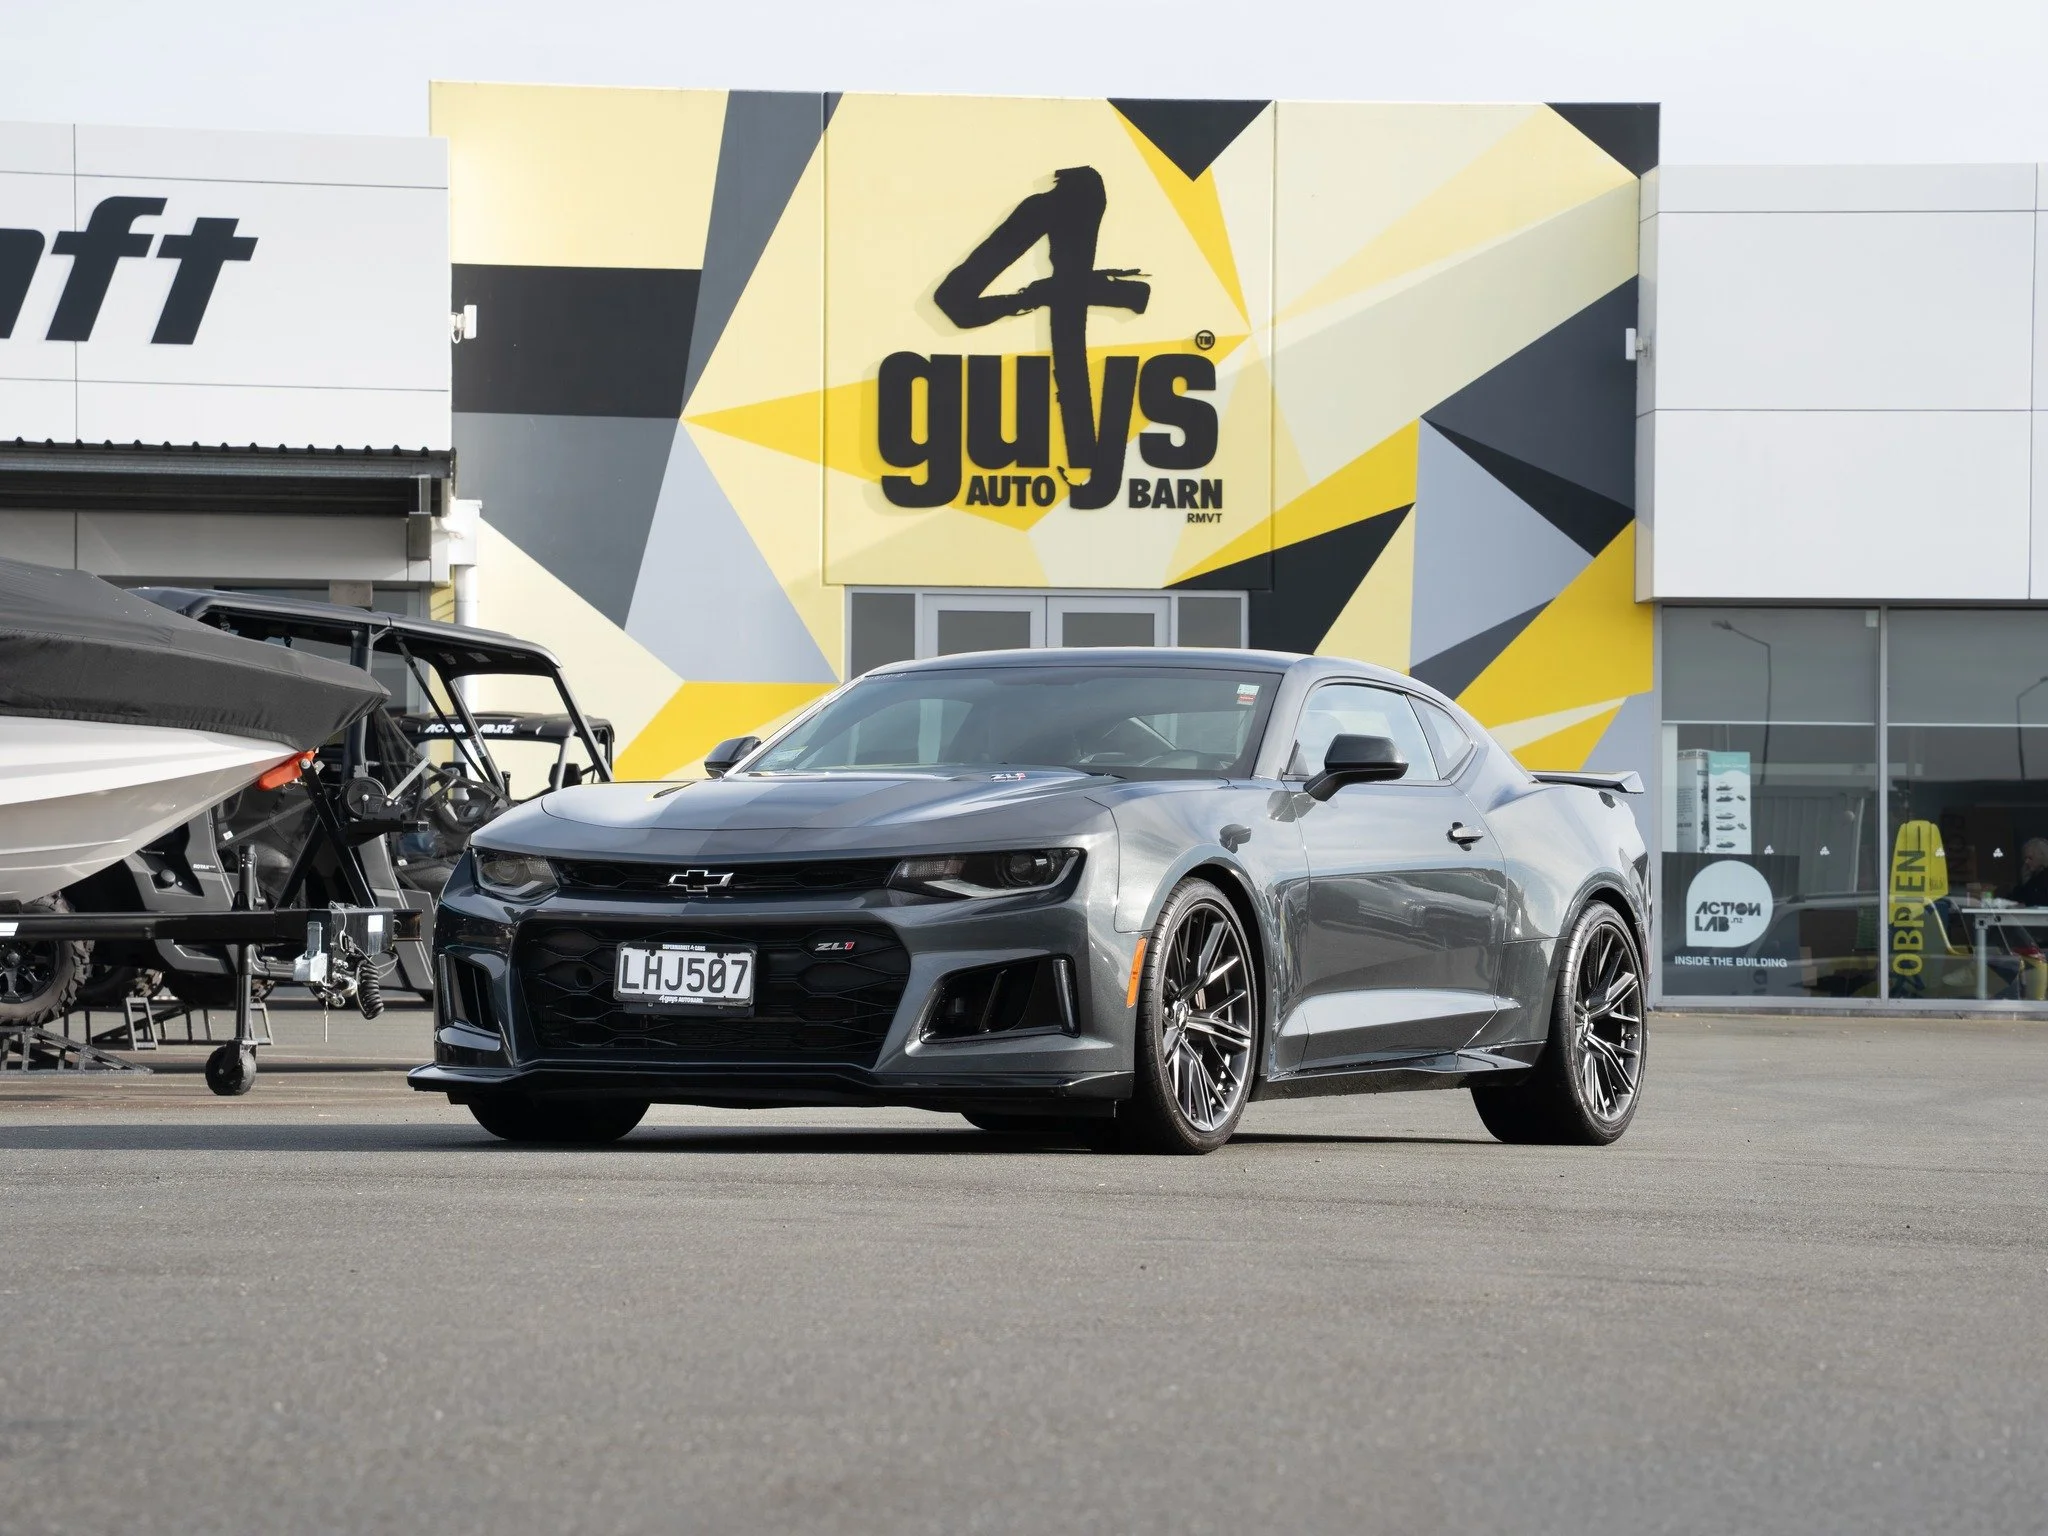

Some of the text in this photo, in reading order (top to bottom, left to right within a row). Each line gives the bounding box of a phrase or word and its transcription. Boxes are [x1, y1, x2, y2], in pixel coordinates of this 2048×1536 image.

[934, 165, 1152, 468] 4
[878, 351, 1218, 510] guys
[966, 475, 1223, 509] AUTO BARN
[1187, 513, 1223, 523] RMVT
[1695, 901, 1761, 916] ACTION
[814, 941, 856, 951] ZL1
[1674, 956, 1788, 968] INSIDE THE BUILDING
[621, 954, 749, 995] LHJ507
